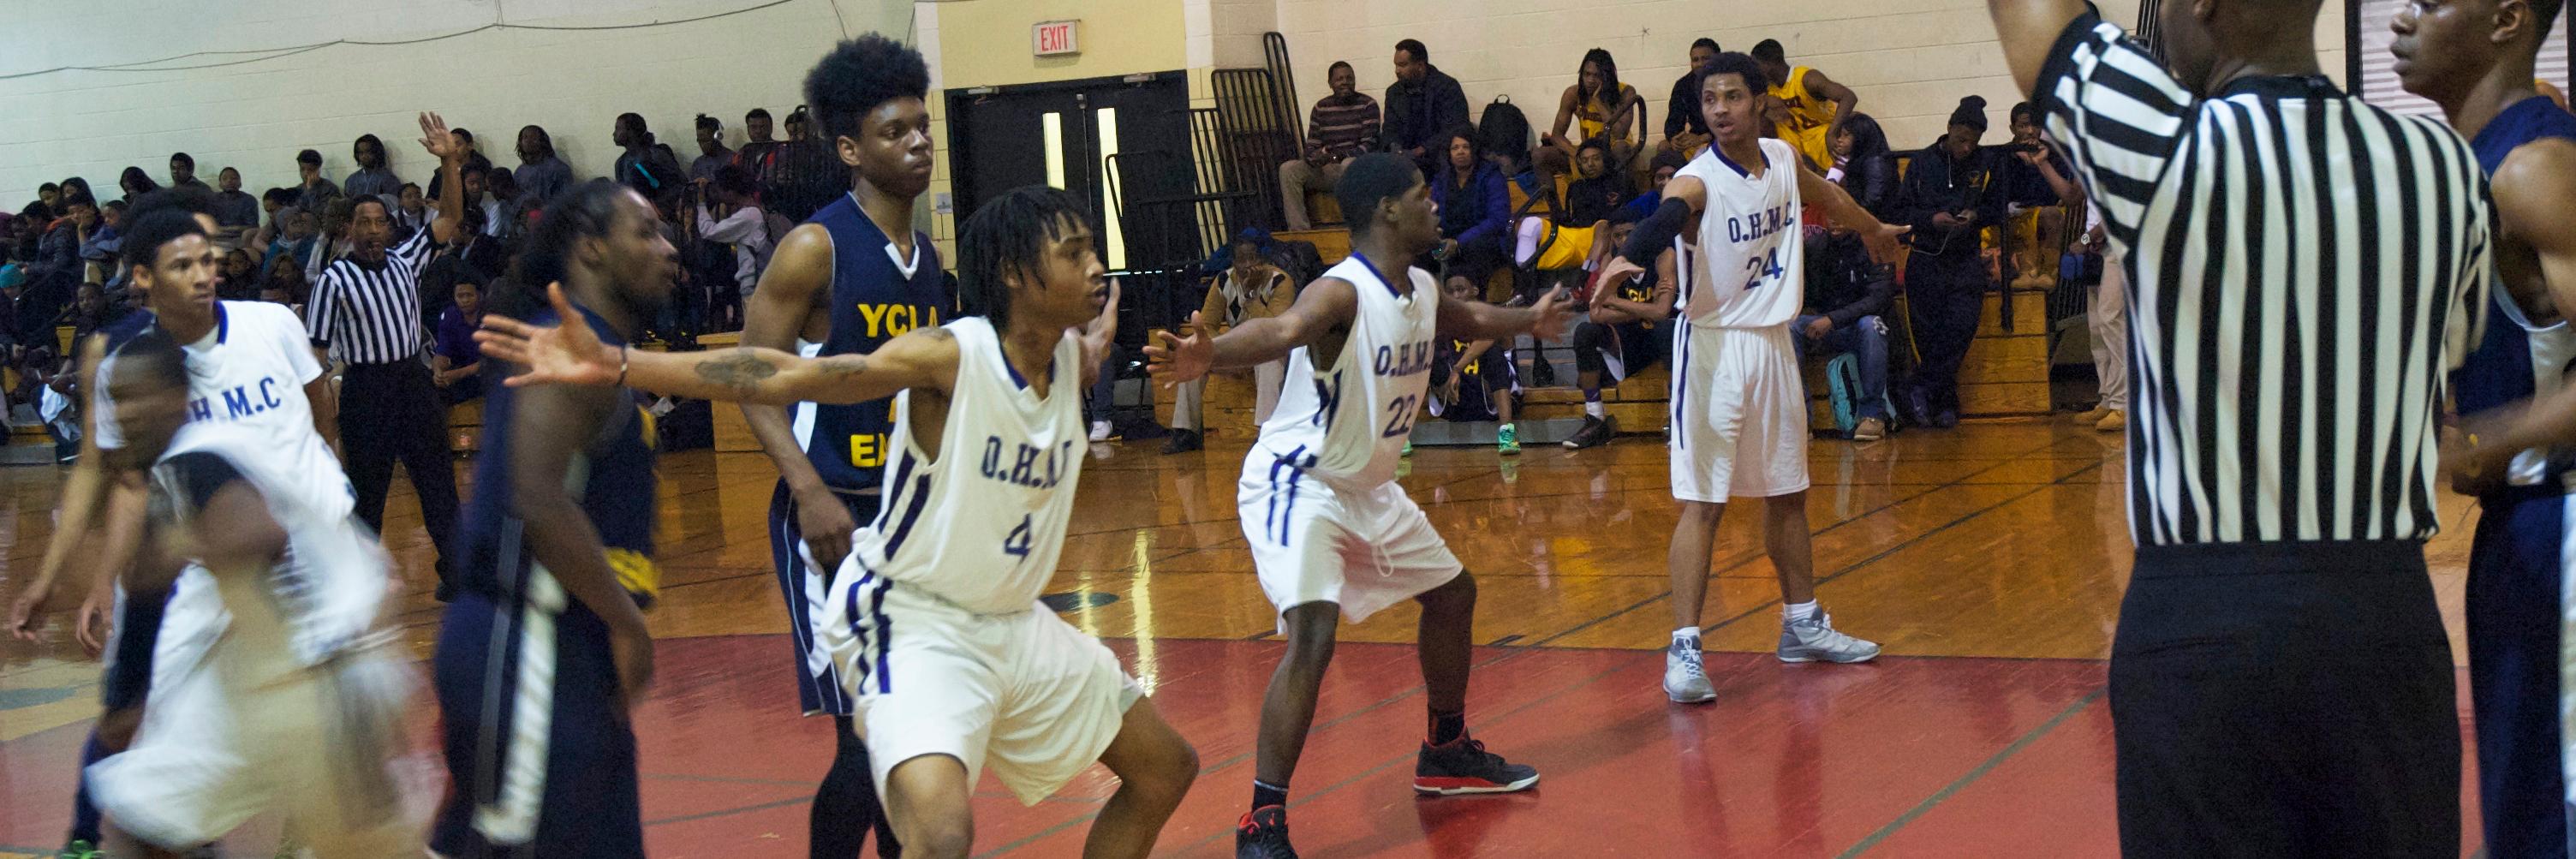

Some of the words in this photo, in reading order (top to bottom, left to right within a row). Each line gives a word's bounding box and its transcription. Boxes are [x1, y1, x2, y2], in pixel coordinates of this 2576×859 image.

[1041, 25, 1069, 51] EXIT
[1743, 246, 1784, 290] 24
[1383, 393, 1416, 438] 22
[1005, 513, 1033, 565] 4
